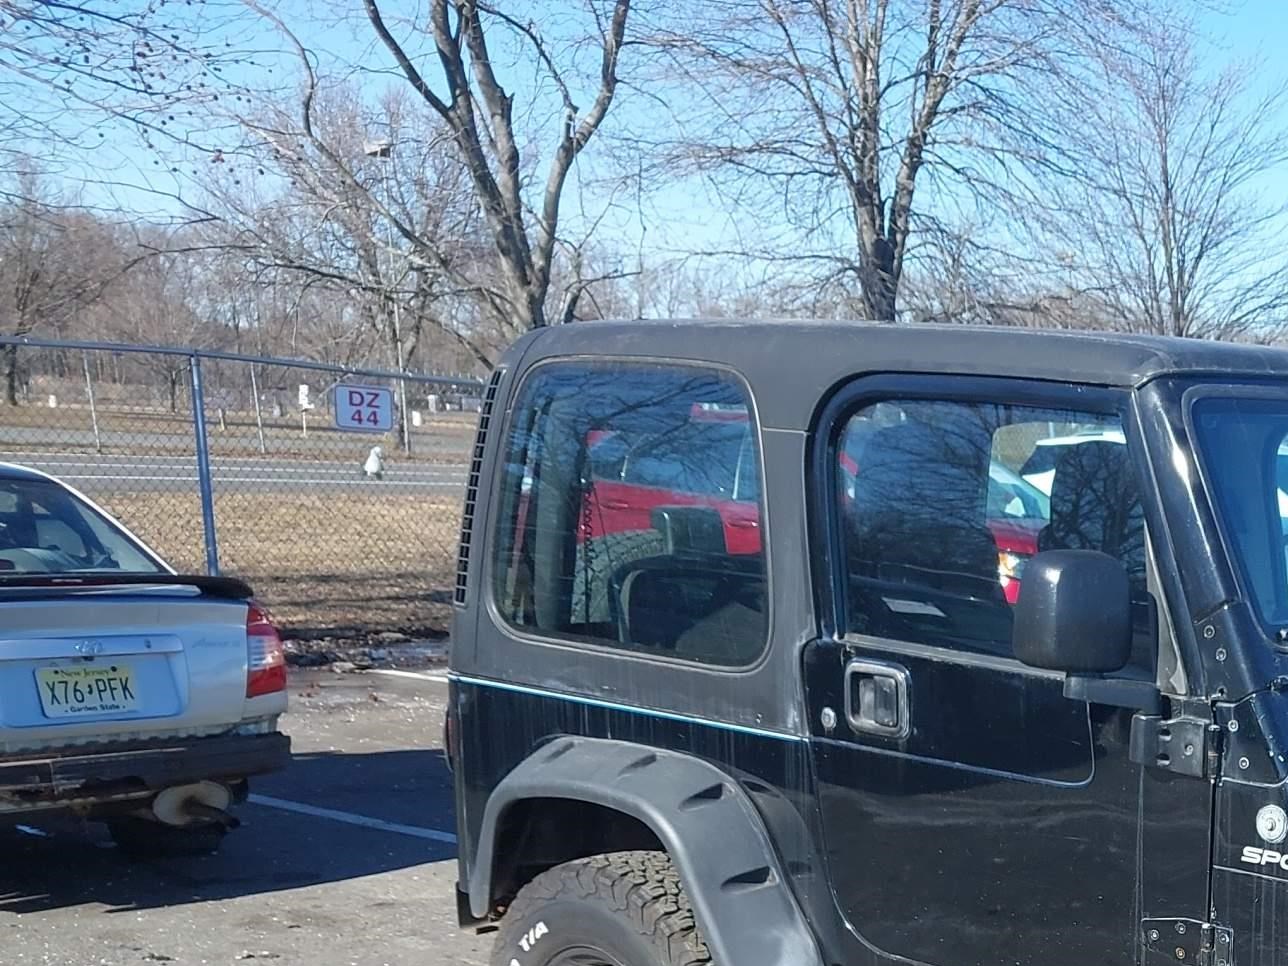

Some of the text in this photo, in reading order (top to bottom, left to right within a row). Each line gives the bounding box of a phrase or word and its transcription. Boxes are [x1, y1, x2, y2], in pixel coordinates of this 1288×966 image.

[348, 390, 380, 408] DZ
[351, 409, 380, 426] 44
[45, 676, 135, 706] X76 PFK
[517, 920, 550, 953] T/A
